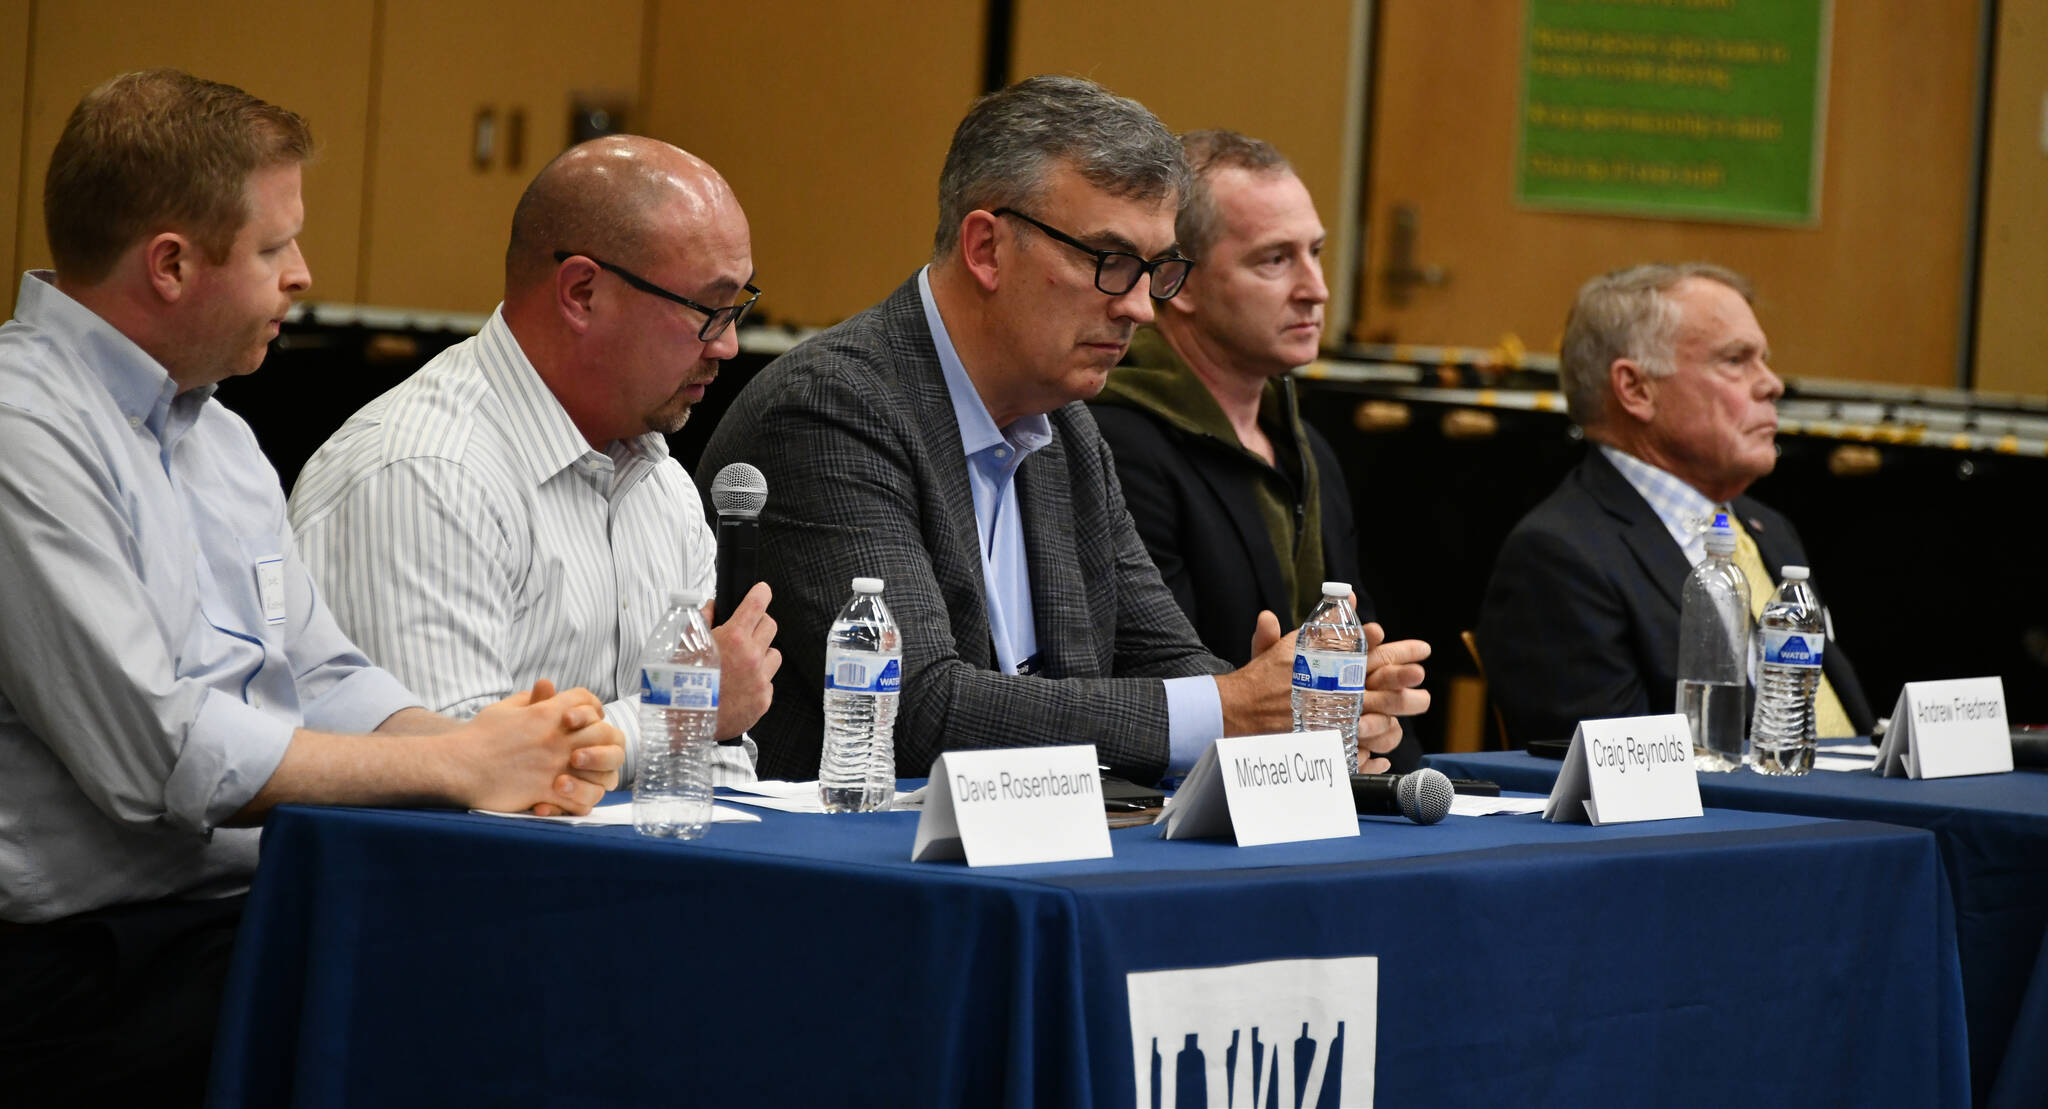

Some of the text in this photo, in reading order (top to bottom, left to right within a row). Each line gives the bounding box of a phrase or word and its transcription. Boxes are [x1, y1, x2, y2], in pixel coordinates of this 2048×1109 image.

[1780, 651, 1810, 660] WATER
[1917, 697, 2001, 723] Andrew Friedman
[1234, 752, 1333, 788] Michael Curry
[1593, 734, 1685, 774] Craig Reynolds
[956, 769, 1094, 802] Dave Rosenbaum
